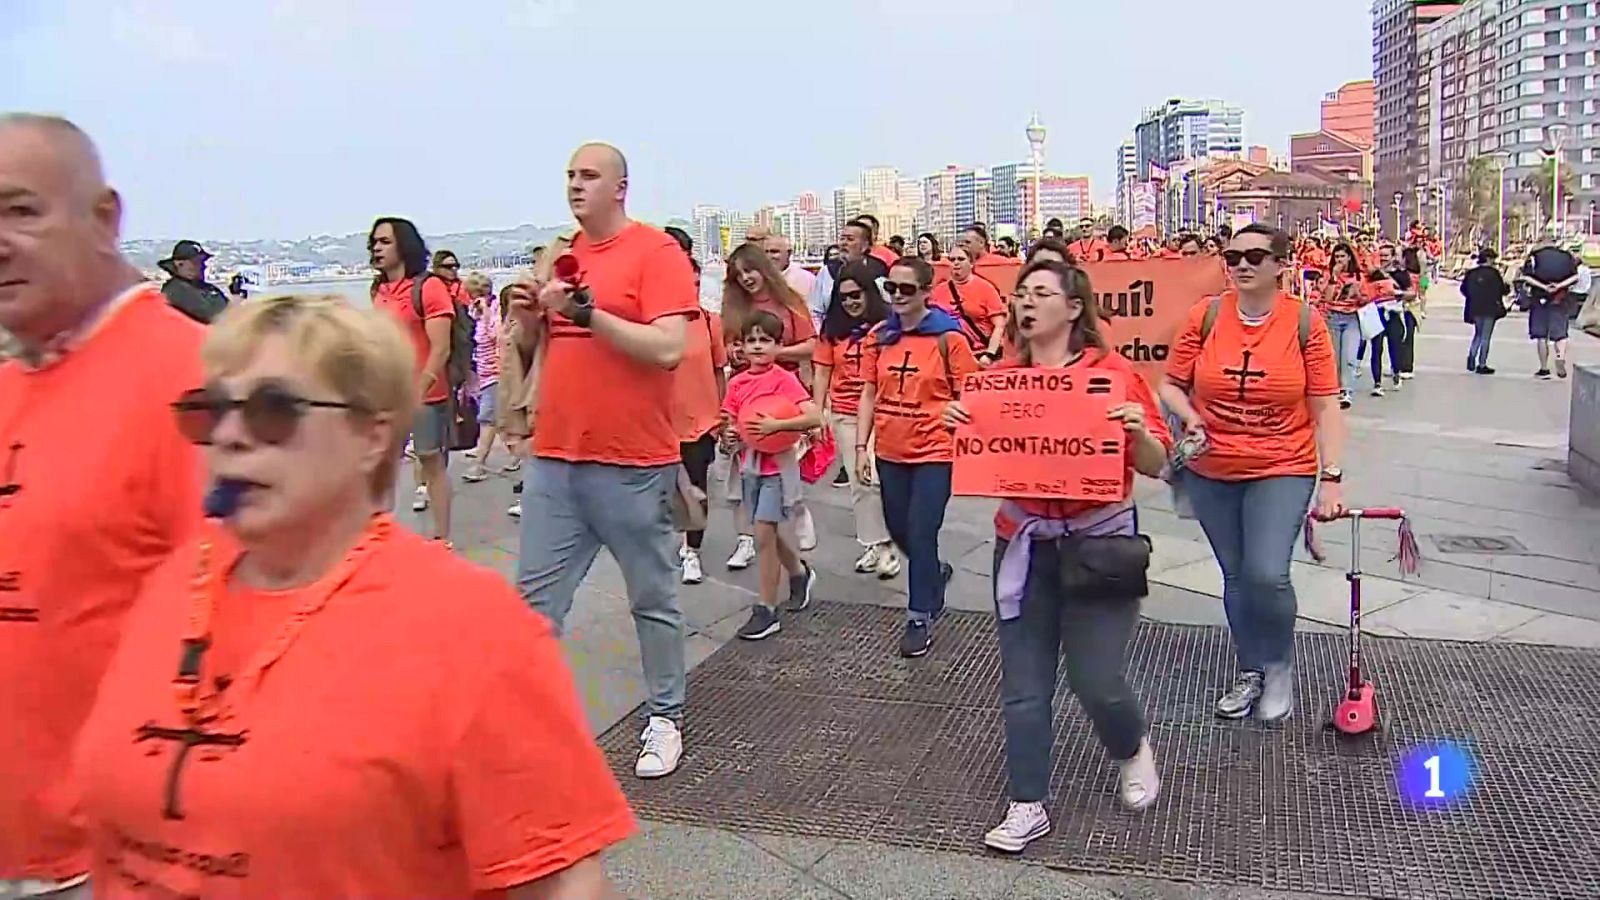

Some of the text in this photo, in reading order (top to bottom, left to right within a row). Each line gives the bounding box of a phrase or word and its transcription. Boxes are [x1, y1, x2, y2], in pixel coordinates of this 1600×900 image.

[1094, 279, 1154, 317] uí!
[1115, 337, 1169, 361] cha
[1000, 402, 1046, 420] PERO
[956, 437, 984, 456] NO
[988, 436, 1096, 456] CONTAMOS
